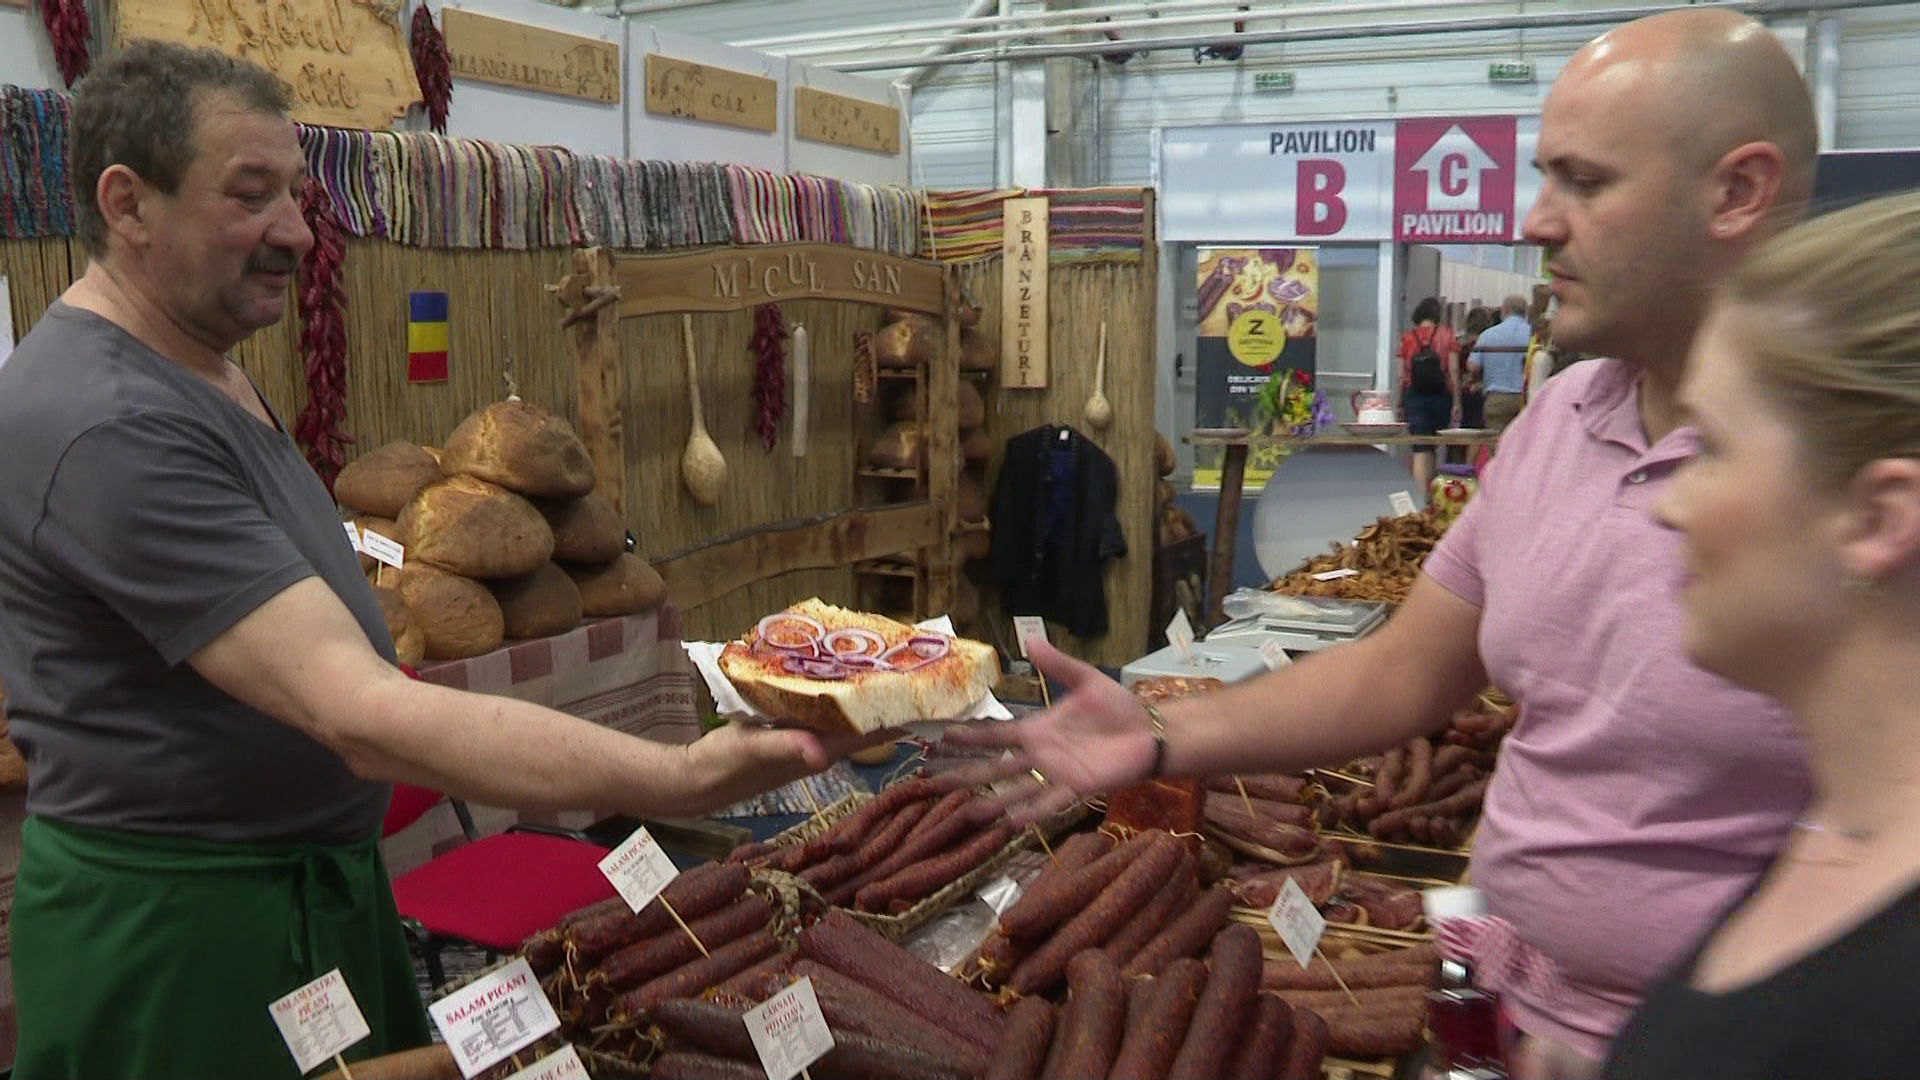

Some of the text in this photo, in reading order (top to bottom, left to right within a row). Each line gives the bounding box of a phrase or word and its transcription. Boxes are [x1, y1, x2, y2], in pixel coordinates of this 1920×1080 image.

[1270, 129, 1376, 154] PAVILION
[1295, 158, 1347, 237] B
[1439, 152, 1469, 197] C
[1402, 211, 1505, 236] PAVILION
[711, 252, 901, 299] MICUL SAN
[1017, 210, 1033, 386] BRANZETURI
[1248, 318, 1265, 335] Z
[446, 995, 487, 1025] SALAM
[486, 972, 528, 1003] PICANT
